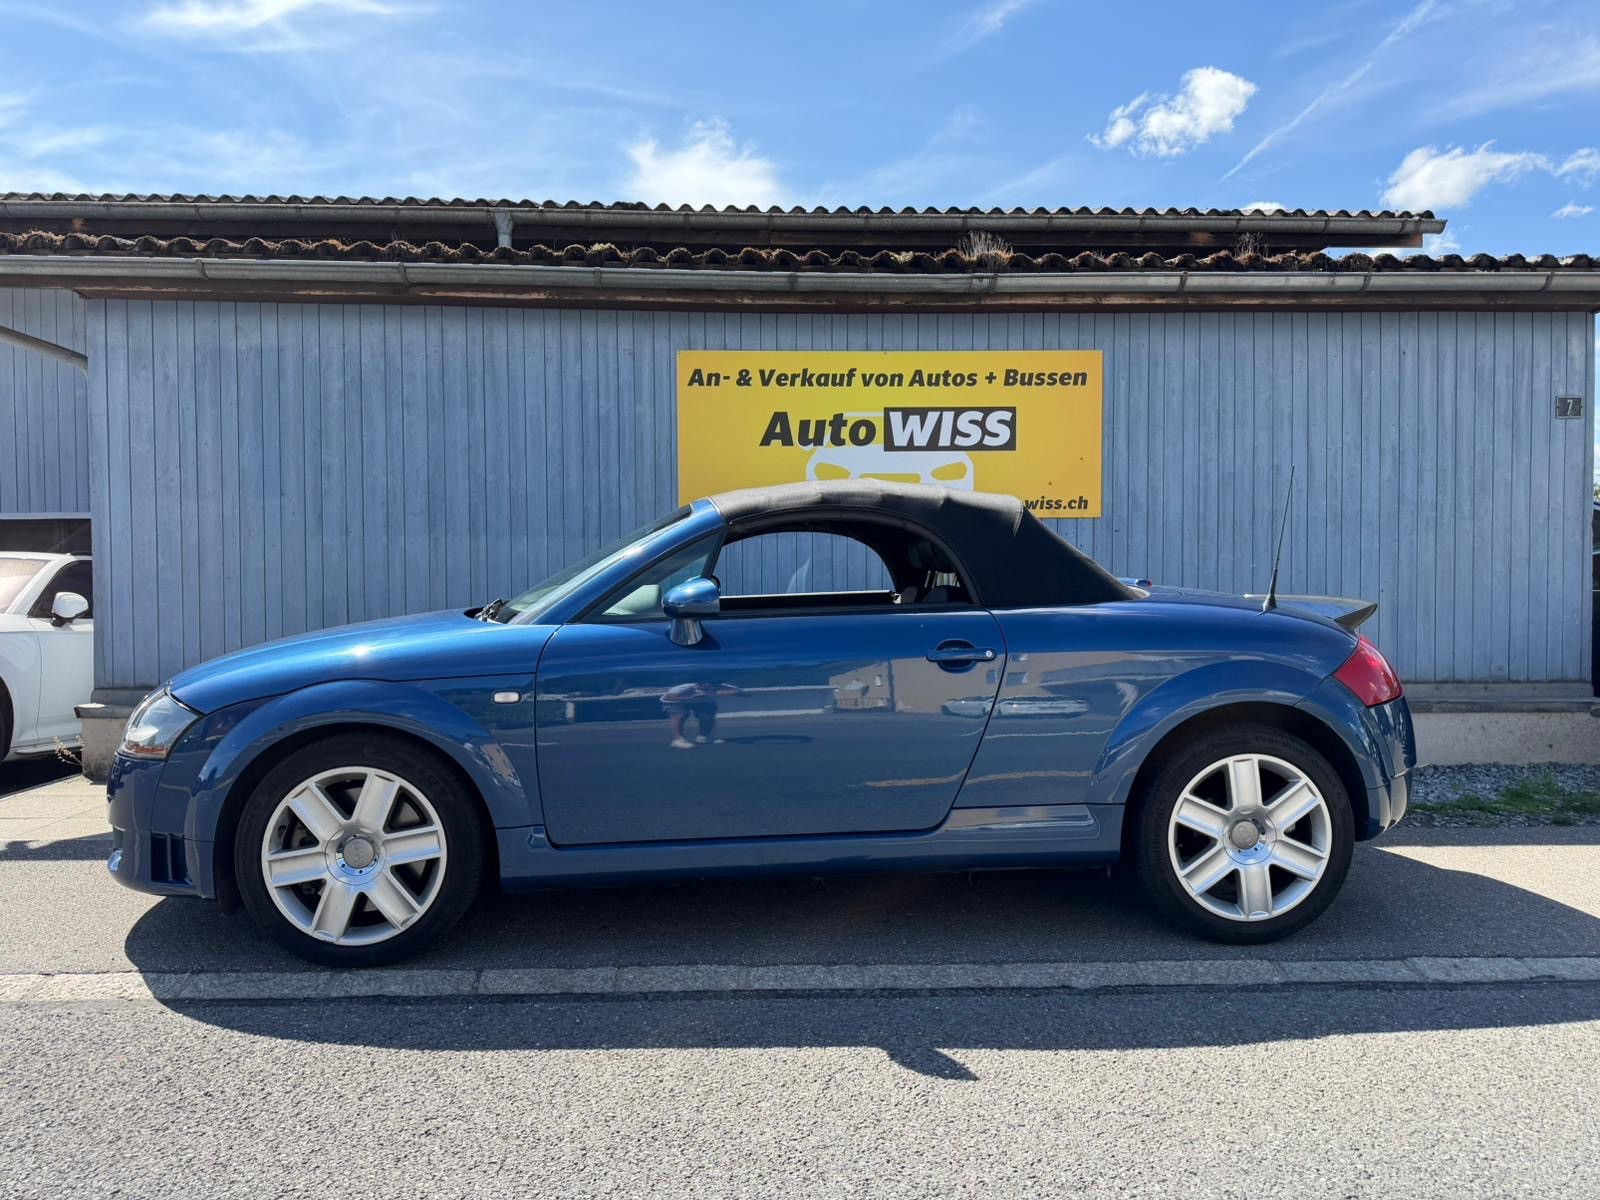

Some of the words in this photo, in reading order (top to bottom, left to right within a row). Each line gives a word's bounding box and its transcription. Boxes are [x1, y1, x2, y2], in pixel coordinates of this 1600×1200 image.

[688, 369, 730, 387] An-
[736, 369, 752, 387] &
[759, 368, 857, 387] Verkauf
[861, 373, 904, 387] von
[908, 369, 978, 387] Autos
[985, 371, 997, 384] +
[1003, 369, 1088, 386] Bussen
[1567, 399, 1573, 416] 7
[759, 411, 876, 447] Auto
[889, 410, 1013, 447] WISS
